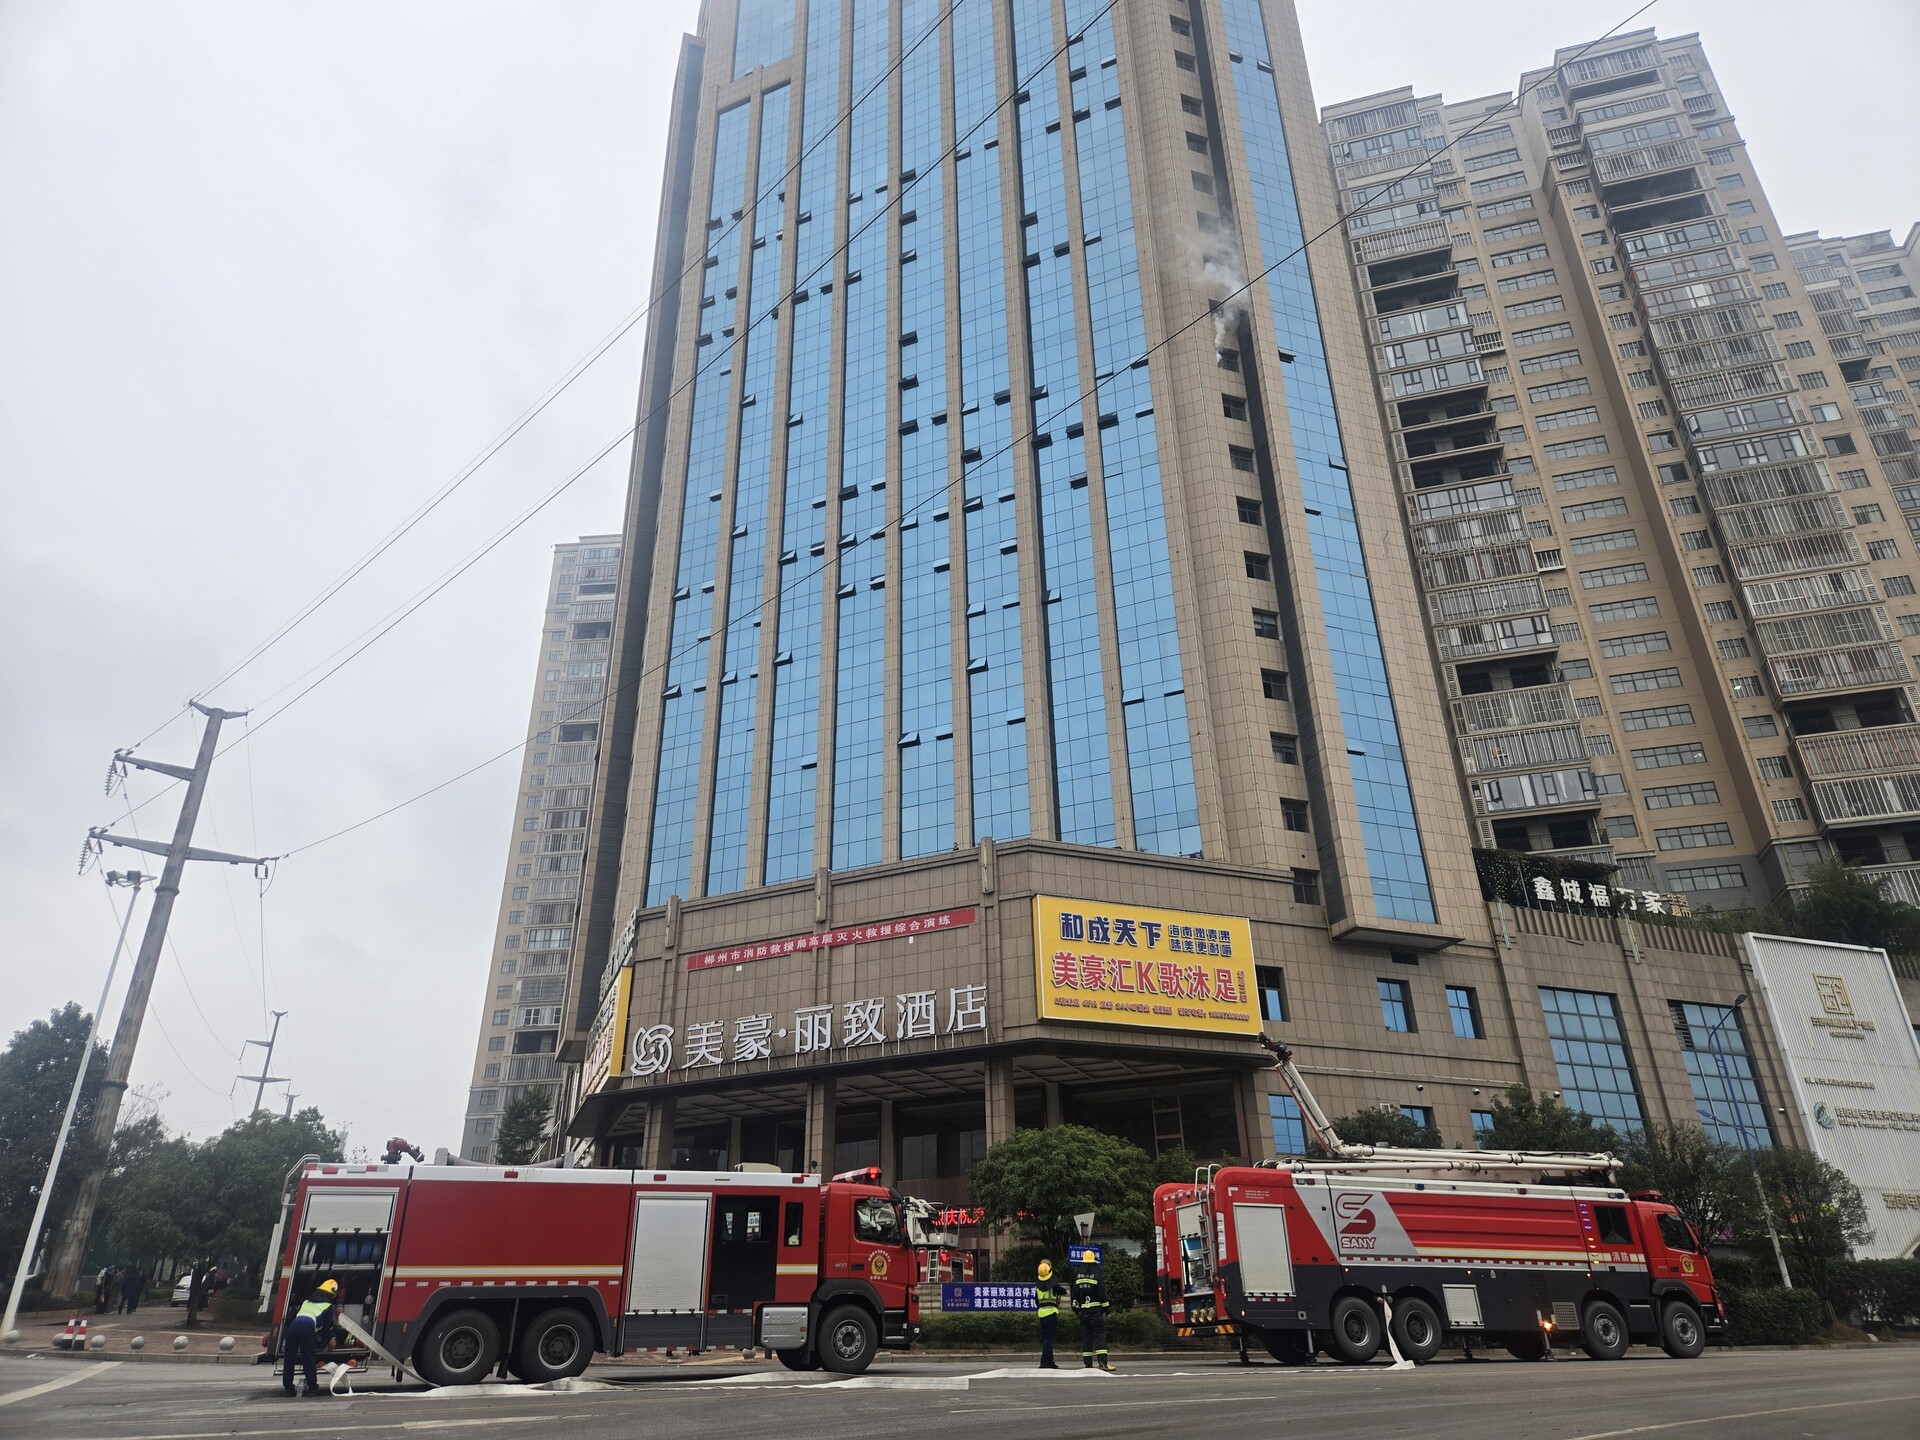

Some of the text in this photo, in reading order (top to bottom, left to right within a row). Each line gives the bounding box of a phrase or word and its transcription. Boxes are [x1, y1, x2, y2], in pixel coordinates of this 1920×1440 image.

[1532, 876, 1667, 915] 鑫城福万家
[1060, 912, 1162, 947] 和成天下
[1052, 951, 1238, 1003] 美豪汇K歌沐足
[1341, 1236, 1376, 1249] SANY
[1612, 1251, 1629, 1262] 消防
